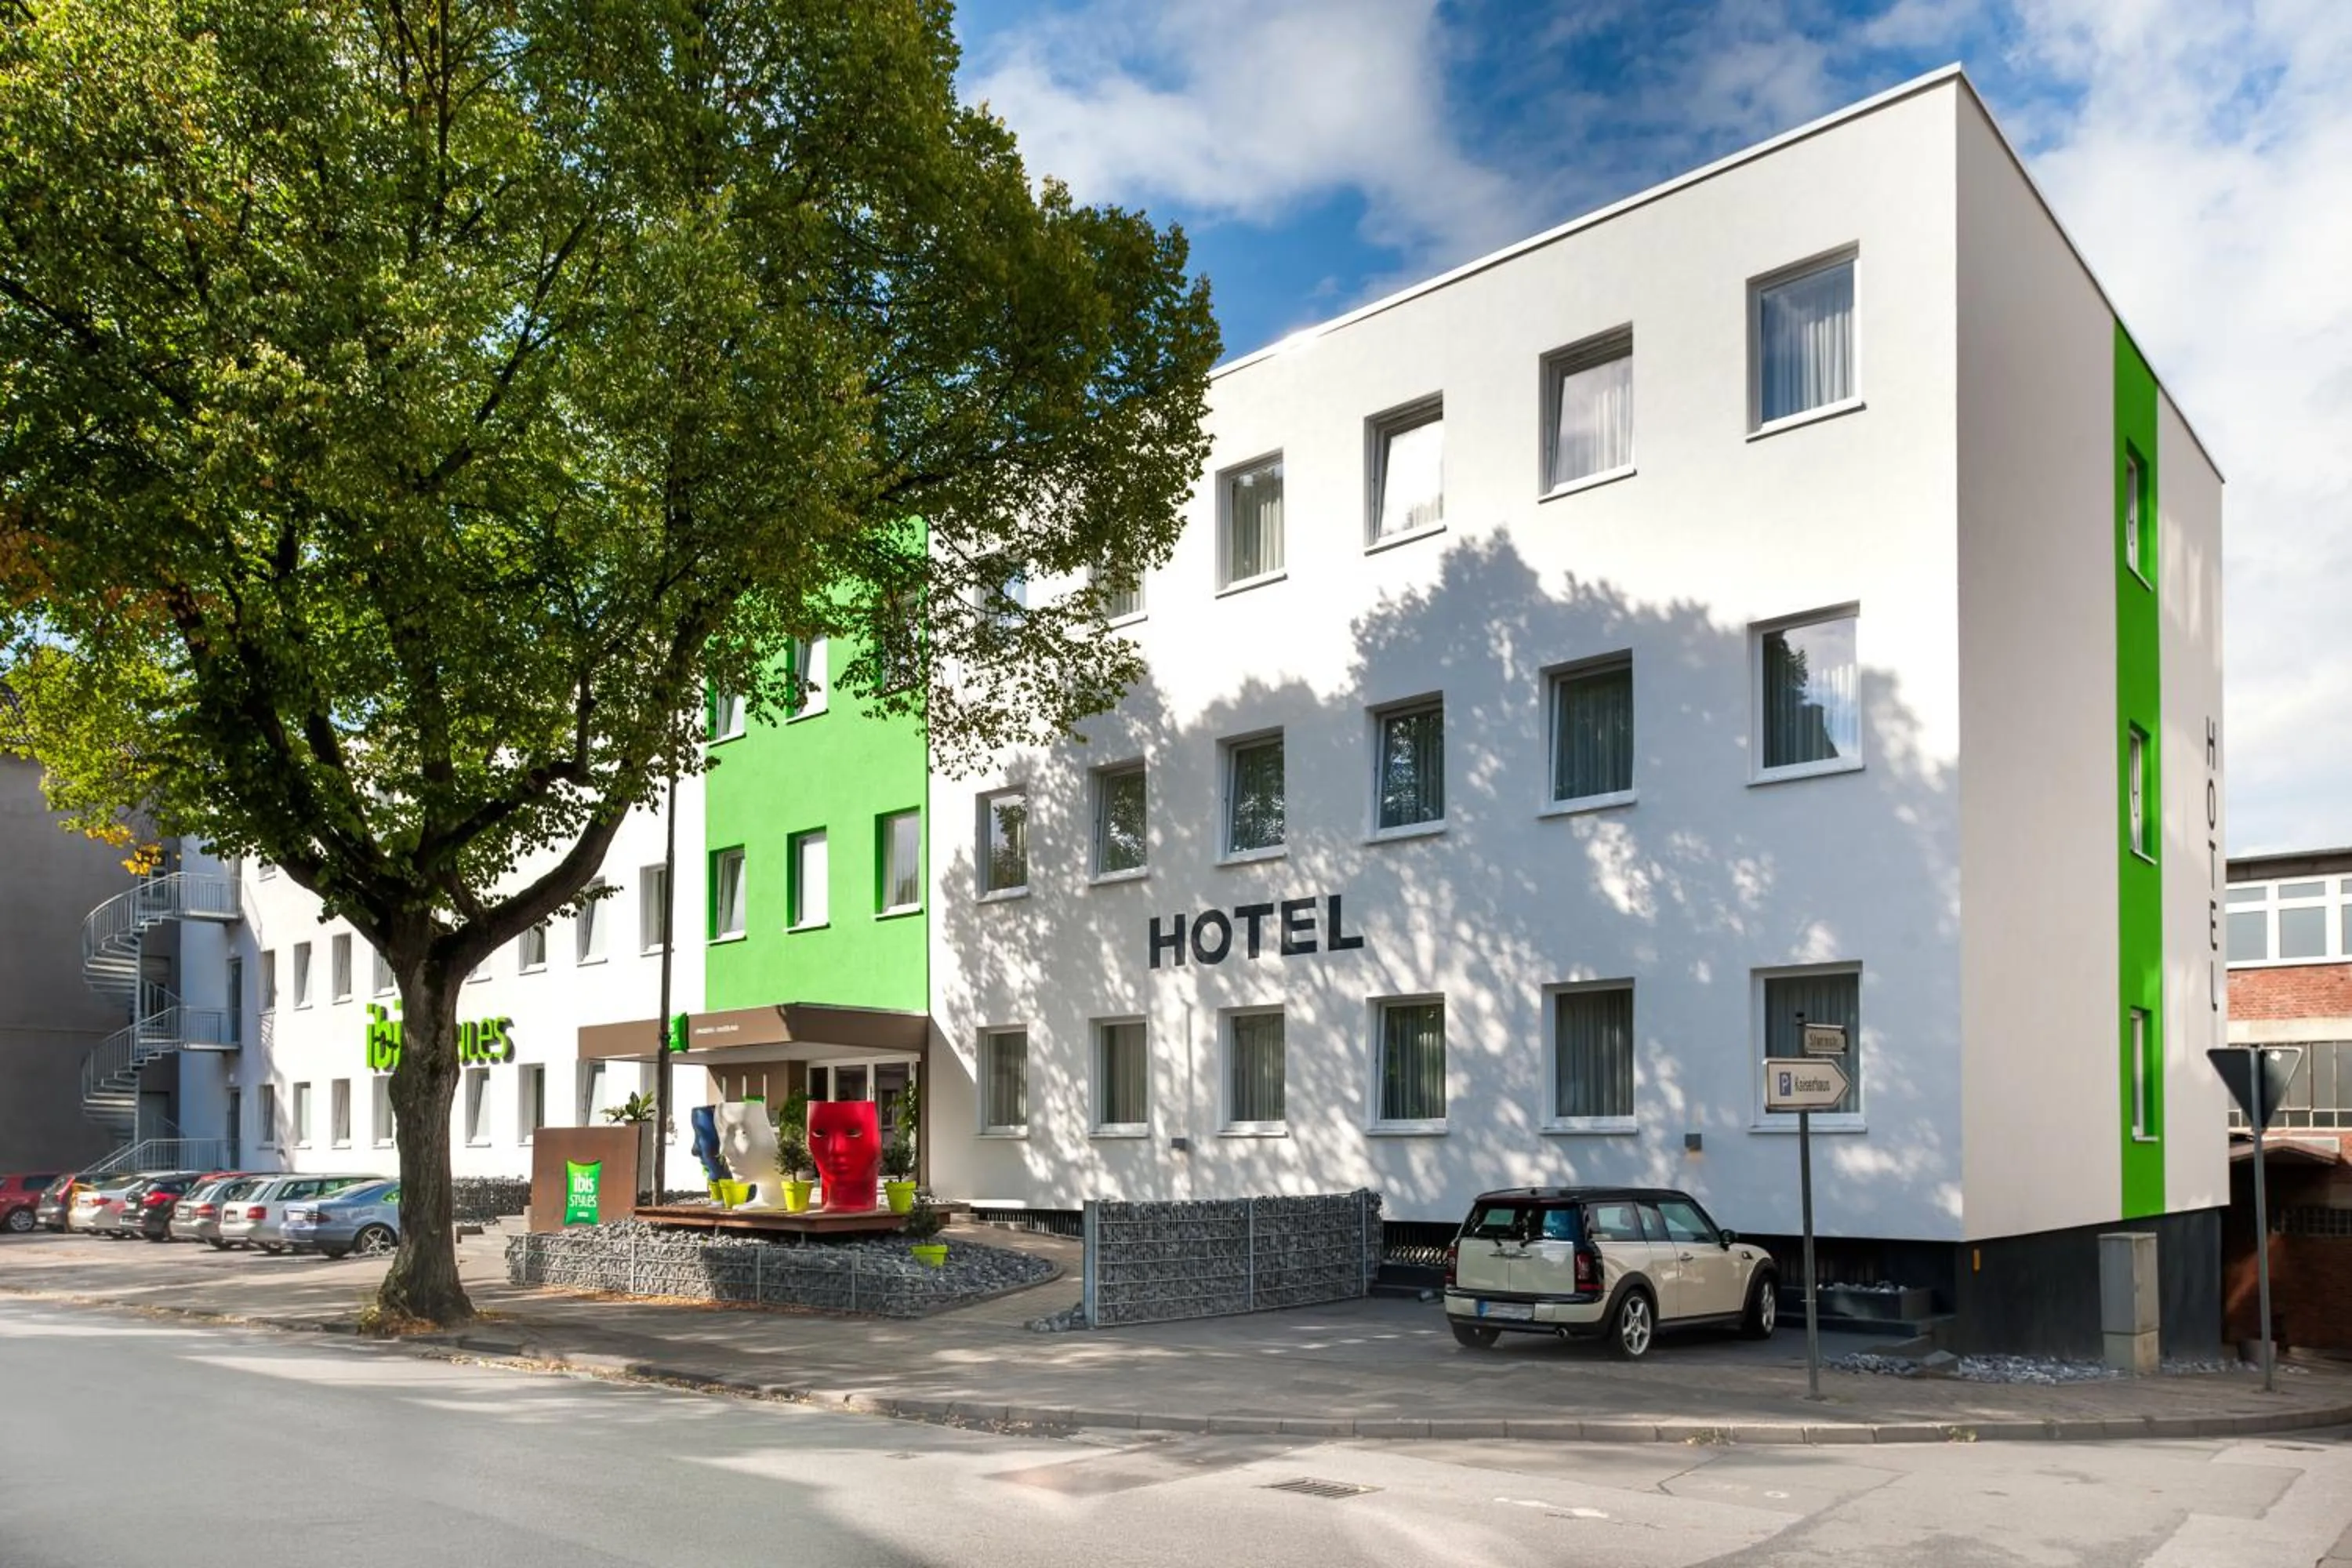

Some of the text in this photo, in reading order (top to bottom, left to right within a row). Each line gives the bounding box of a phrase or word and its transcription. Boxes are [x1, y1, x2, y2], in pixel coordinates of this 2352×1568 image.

[2206, 716, 2218, 1012] HOTEL
[1149, 895, 1364, 969] HOTEL
[366, 1000, 402, 1072] ibi
[573, 1172, 595, 1193] ibis
